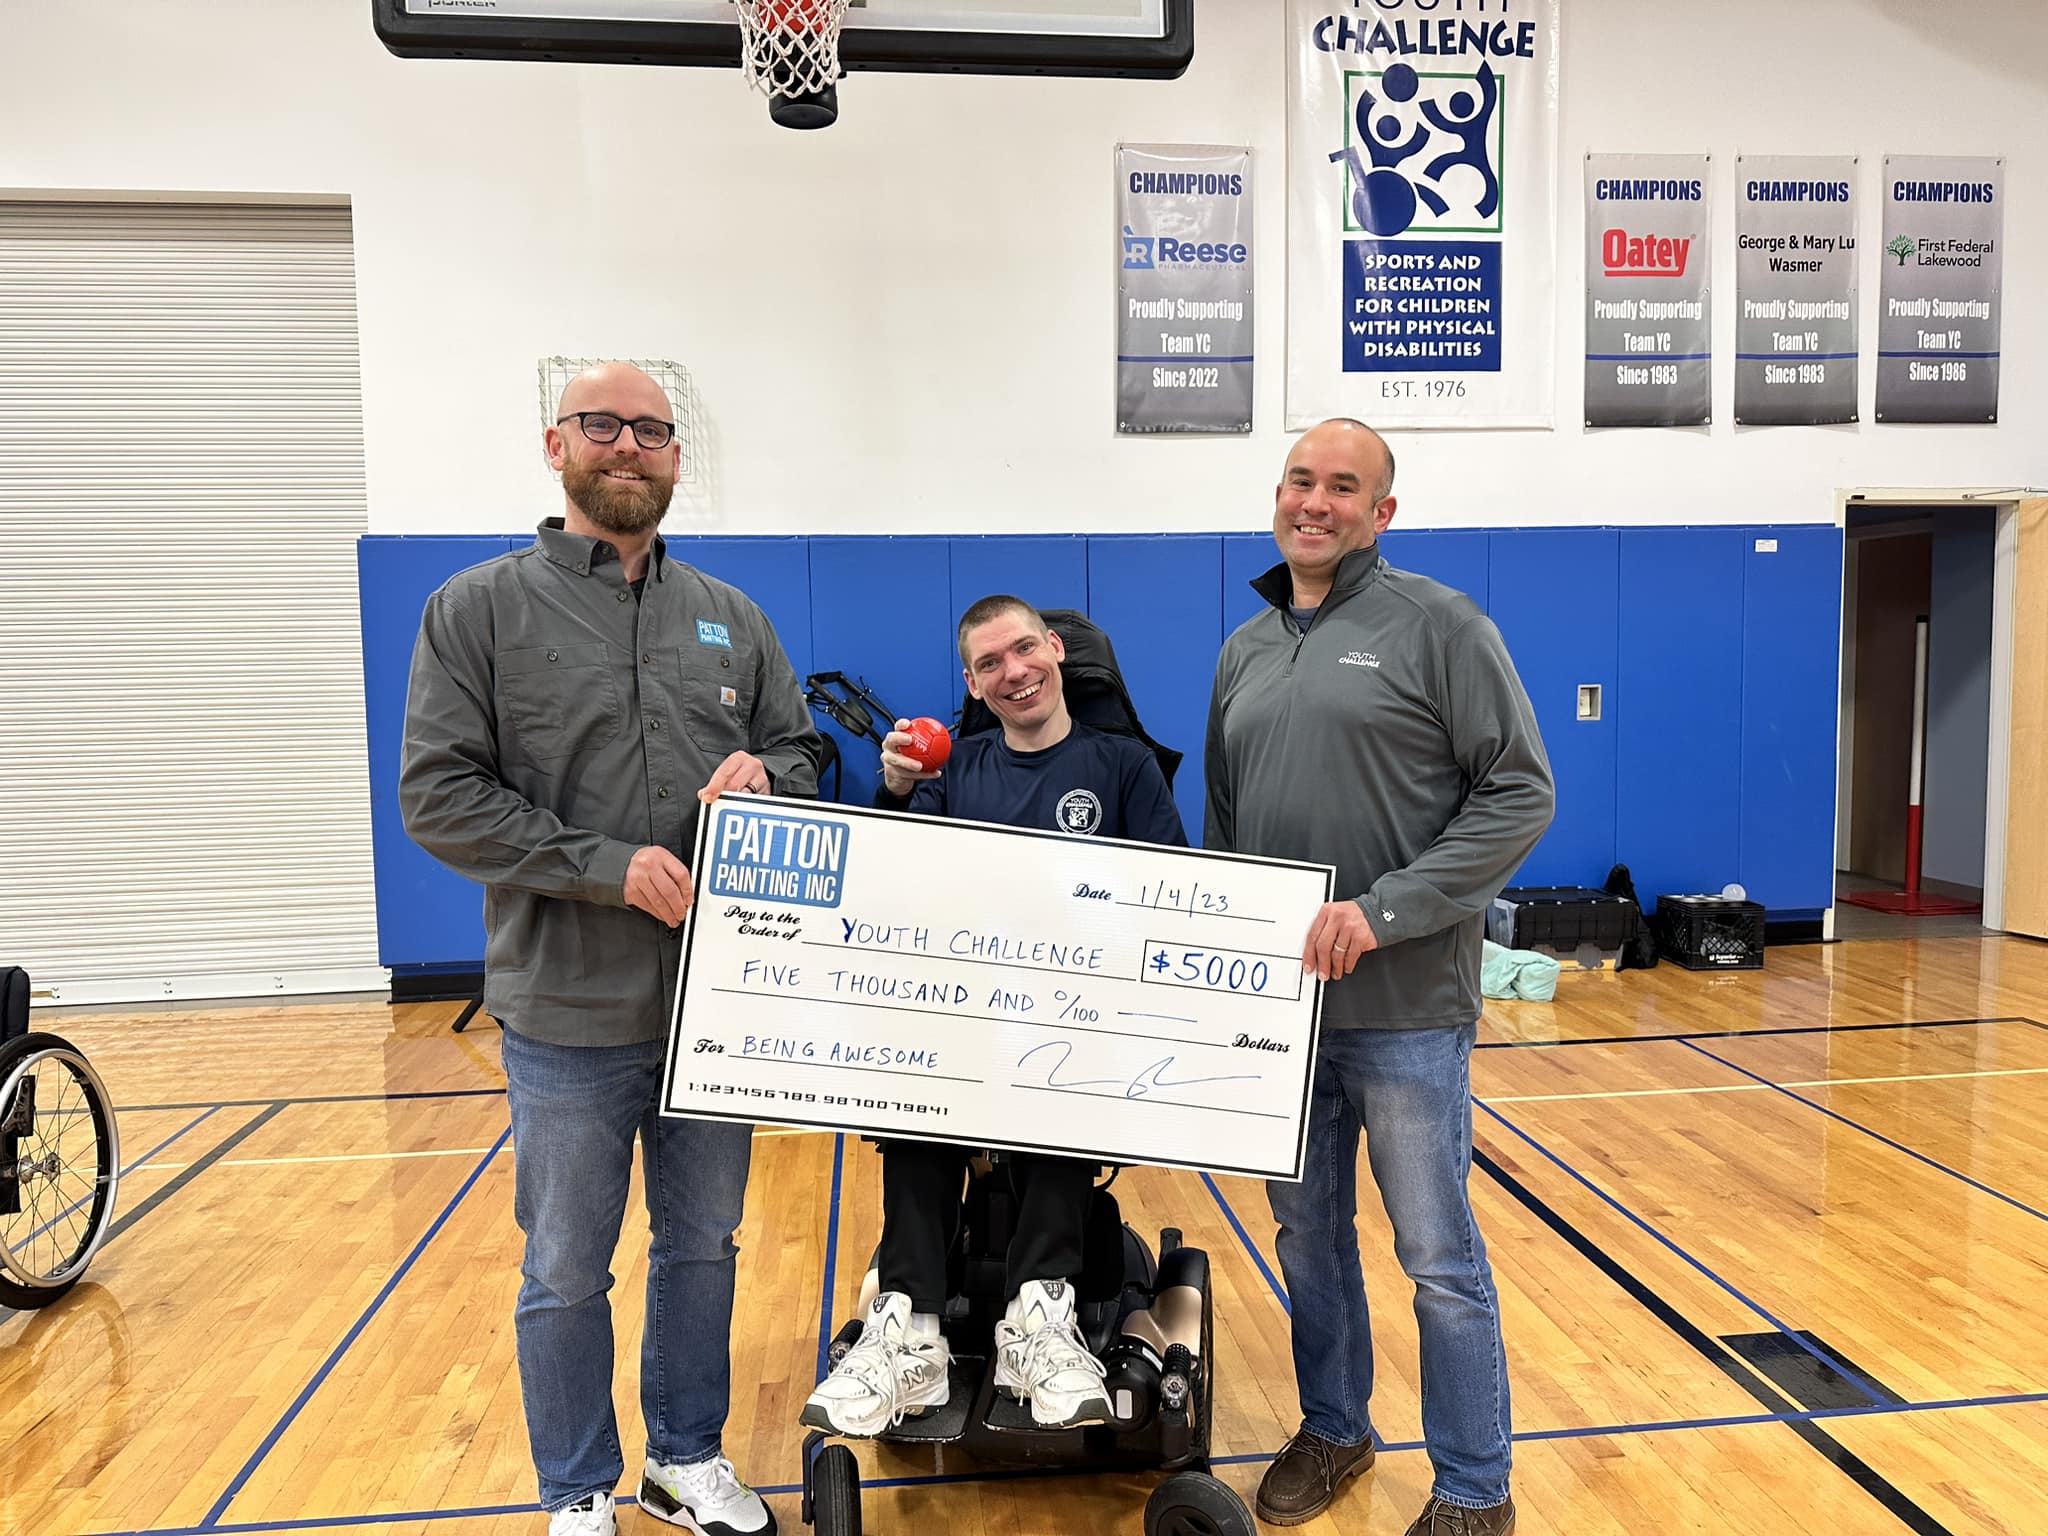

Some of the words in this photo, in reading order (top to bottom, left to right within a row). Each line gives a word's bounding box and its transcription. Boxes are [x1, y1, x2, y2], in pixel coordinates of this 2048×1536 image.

[1312, 15, 1536, 58] CHALLENGE
[1129, 172, 1243, 196] CHAMPIONS
[1596, 179, 1702, 201] CHAMPIONS
[1747, 181, 1849, 202] CHAMPIONS
[1893, 181, 1993, 203] CHAMPIONS
[1158, 237, 1247, 264] Reese
[1603, 229, 1690, 277] Oatey
[1738, 234, 1785, 251] George
[1789, 235, 1799, 249] &
[1803, 235, 1835, 253] Mary
[1839, 236, 1855, 249] Lu
[1918, 239, 1946, 252] First
[1948, 239, 1994, 253] Federal
[1365, 255, 1435, 270] SPORTS
[1438, 255, 1481, 270] AND
[1769, 258, 1822, 272] Wasmer
[1918, 253, 1981, 267] Lakewood
[1364, 277, 1481, 292] RECREATION
[1129, 298, 1175, 320] Proudly
[1177, 298, 1243, 322] Supporting
[1355, 299, 1393, 313] FOR
[1397, 299, 1490, 313] CHILDREN
[1594, 299, 1638, 320] Proudly
[1639, 300, 1702, 320] Supporting
[1744, 299, 1786, 320] Proudly
[1788, 299, 1849, 320] Supporting
[1888, 298, 1932, 318] Proudly
[1932, 299, 1990, 320] Supporting
[1349, 320, 1401, 335] WITH
[1406, 320, 1495, 335] PHYSICAL
[1160, 333, 1193, 353] Team
[1195, 333, 1211, 353] YC
[1364, 342, 1482, 357] DISABILITIES
[1624, 333, 1654, 352] Team
[1656, 333, 1671, 352] YC
[1772, 332, 1803, 351] Team
[1804, 332, 1818, 351] YC
[1917, 330, 1946, 349] Team
[1948, 330, 1961, 349] YC
[1152, 367, 1187, 388] Since
[1188, 367, 1218, 388] 2022
[1617, 365, 1648, 384] Since
[1650, 365, 1678, 385] 1983
[1765, 365, 1796, 384] Since
[1798, 364, 1824, 384] 1983
[1909, 362, 1939, 381] Since
[1940, 362, 1966, 381] 1986
[1381, 381, 1417, 398] EST.
[1424, 380, 1466, 398] 1976
[698, 620, 728, 638] PATTON
[720, 814, 843, 872] PATTON
[715, 863, 800, 898] PAINTING
[804, 873, 837, 902] INC
[1073, 883, 1111, 901] Date
[1141, 880, 1229, 918] 1/4/23
[723, 905, 756, 923] Pay
[760, 911, 774, 922] to
[777, 912, 800, 925] the
[738, 924, 779, 938] Order
[782, 928, 802, 941] of
[841, 918, 928, 951] YOUTH
[949, 930, 1104, 970] CHALLENGE
[1150, 950, 1268, 992] $5000
[743, 959, 801, 986] FIVE
[828, 970, 969, 1005] THOUSAND
[988, 989, 1034, 1012] AND
[694, 1039, 725, 1054] For
[742, 1036, 815, 1059] BEING
[830, 1042, 939, 1068] AWESOME
[1231, 1033, 1291, 1053] Dollars
